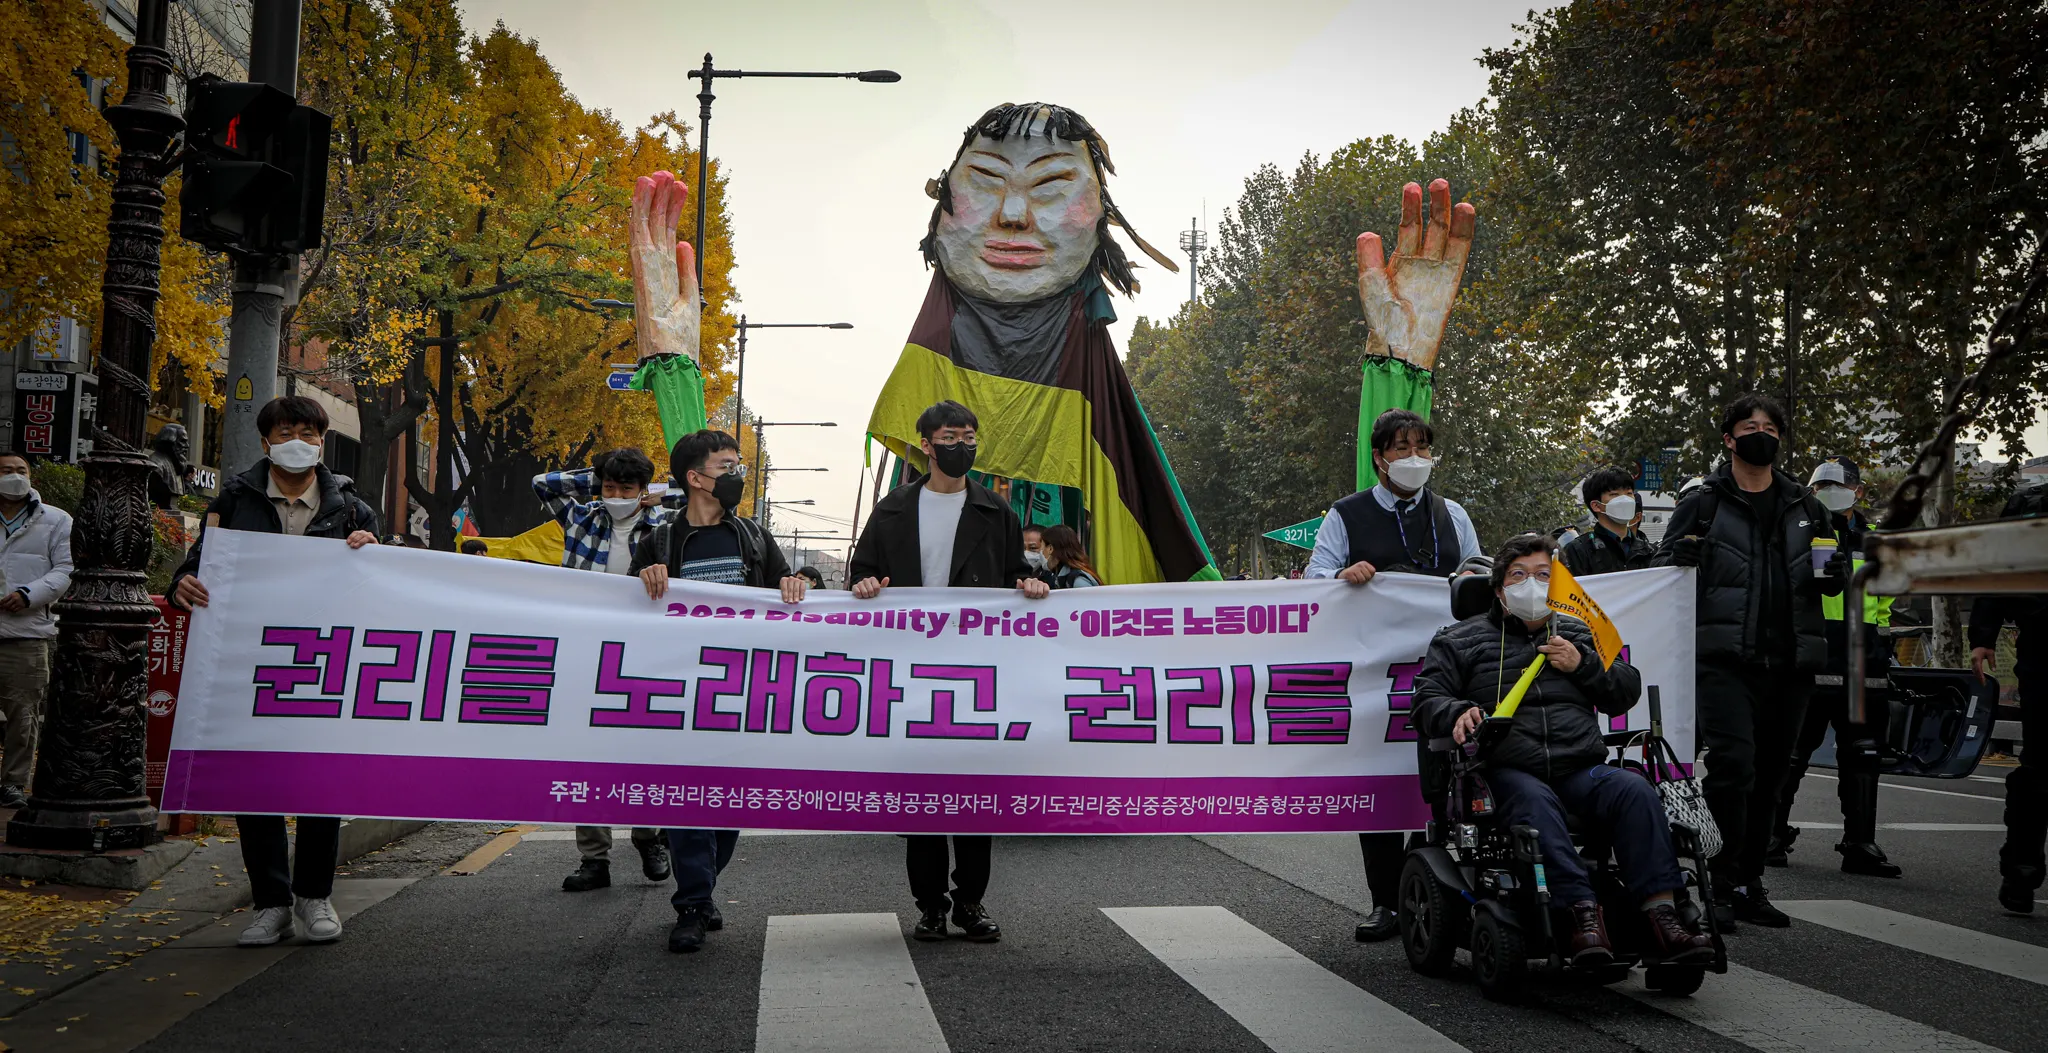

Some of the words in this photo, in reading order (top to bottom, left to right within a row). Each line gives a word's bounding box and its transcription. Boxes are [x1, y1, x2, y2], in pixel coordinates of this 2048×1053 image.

[34, 375, 64, 389] 감악산
[24, 394, 56, 454] 냉면
[233, 404, 252, 414] 종로
[175, 615, 186, 629] Fire
[958, 608, 1060, 638] Pride
[151, 615, 171, 675] 소화기
[172, 631, 185, 673] Extinguisher
[252, 625, 559, 726] 권리를
[589, 640, 1032, 741] 노래하고,
[1064, 661, 1353, 745] 권리를
[549, 781, 590, 803] 주관
[606, 782, 1003, 816] 서울형권리중심중증장애인맞춤형공공일자리,
[1010, 793, 1376, 816] 경기도권리중심중증장애인맞춤형공공일자리
